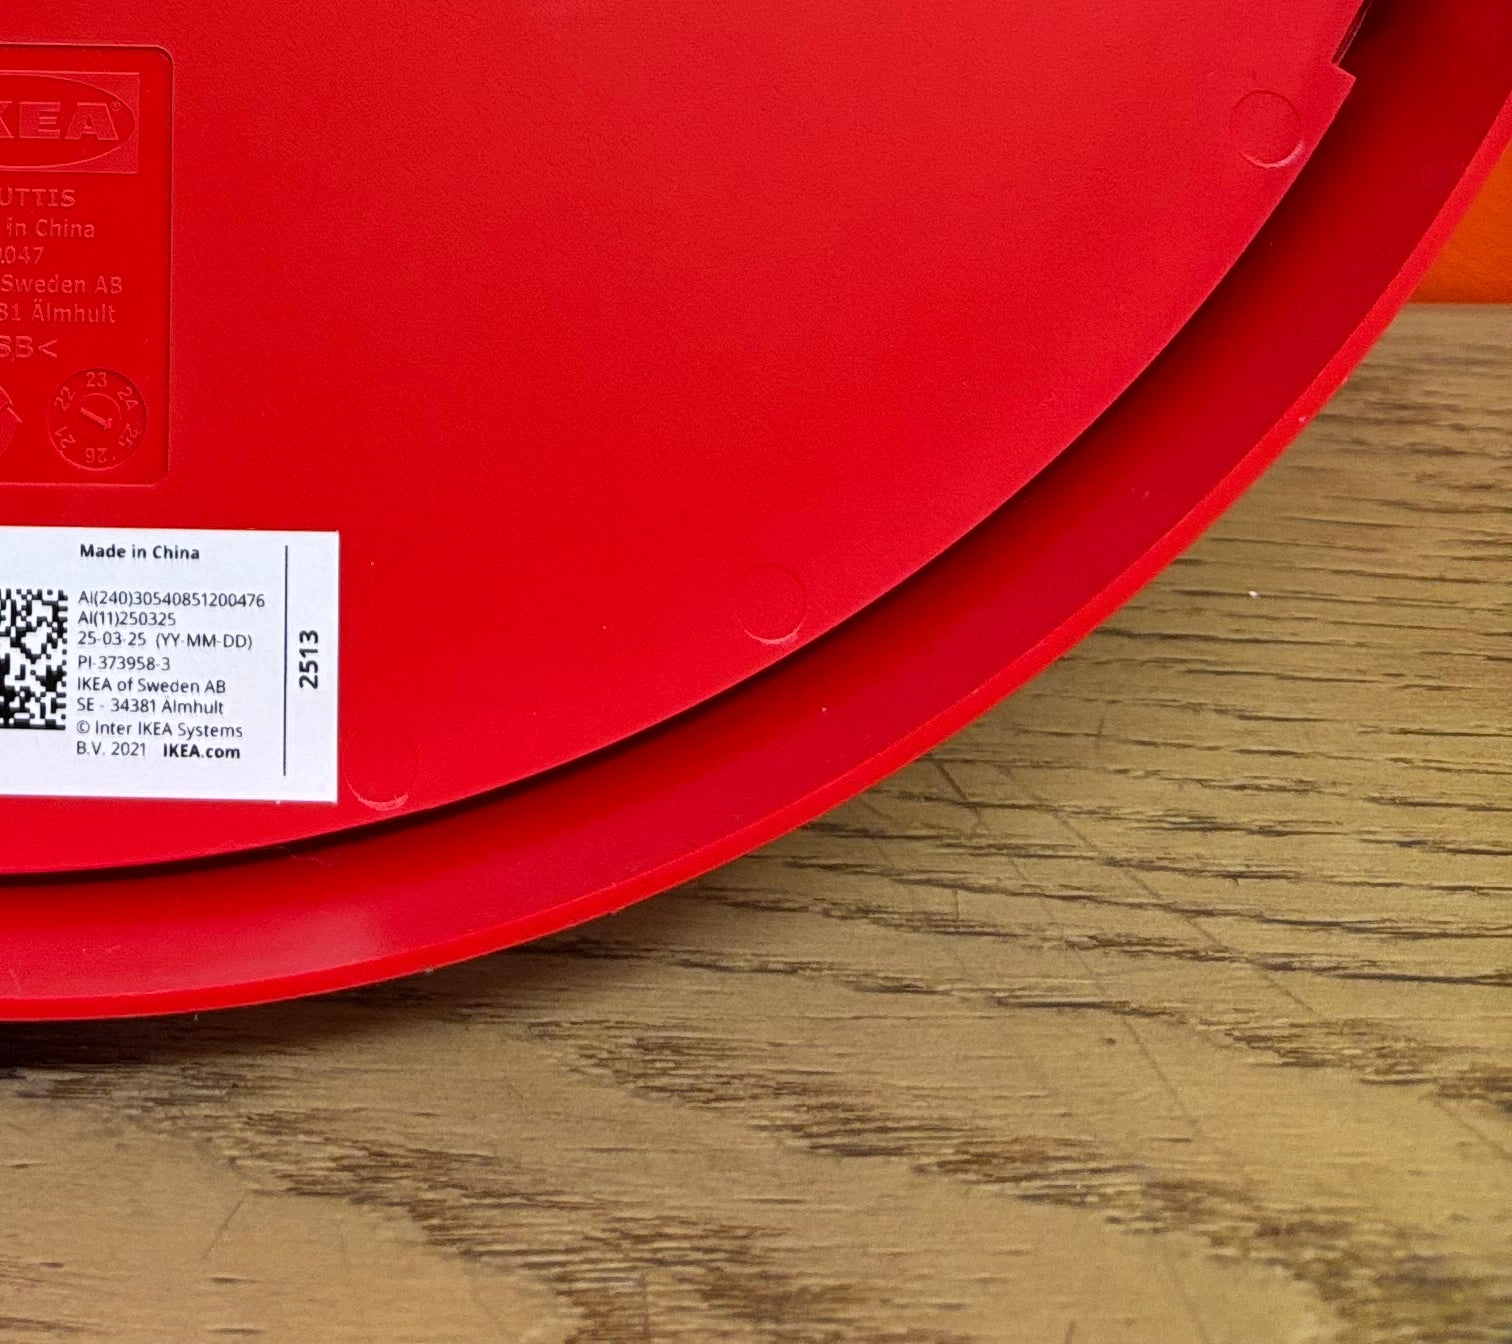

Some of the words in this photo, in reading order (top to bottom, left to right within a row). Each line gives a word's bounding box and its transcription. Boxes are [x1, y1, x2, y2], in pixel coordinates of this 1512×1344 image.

[6, 217, 28, 237] in
[35, 218, 95, 239] China
[0, 274, 86, 294] Sweden
[94, 276, 123, 294] AB
[31, 298, 116, 324] Älmhult
[86, 371, 108, 388] 23
[80, 544, 126, 559] Made
[132, 544, 147, 559] in
[152, 545, 200, 560] China
[77, 631, 146, 646] 25-03-25
[155, 632, 253, 650] (YY-MM-DD)
[298, 629, 319, 689] 2513
[77, 676, 112, 691] IKEA
[117, 677, 133, 692] of
[137, 678, 200, 694] Sweden
[204, 679, 226, 694] AB
[76, 697, 95, 712] SE
[110, 698, 156, 713] 34381
[95, 720, 132, 736] Inter
[138, 722, 173, 736] IKEA
[177, 722, 243, 741] Systems
[110, 741, 146, 757] 2021
[163, 743, 241, 759] IKEA.com
